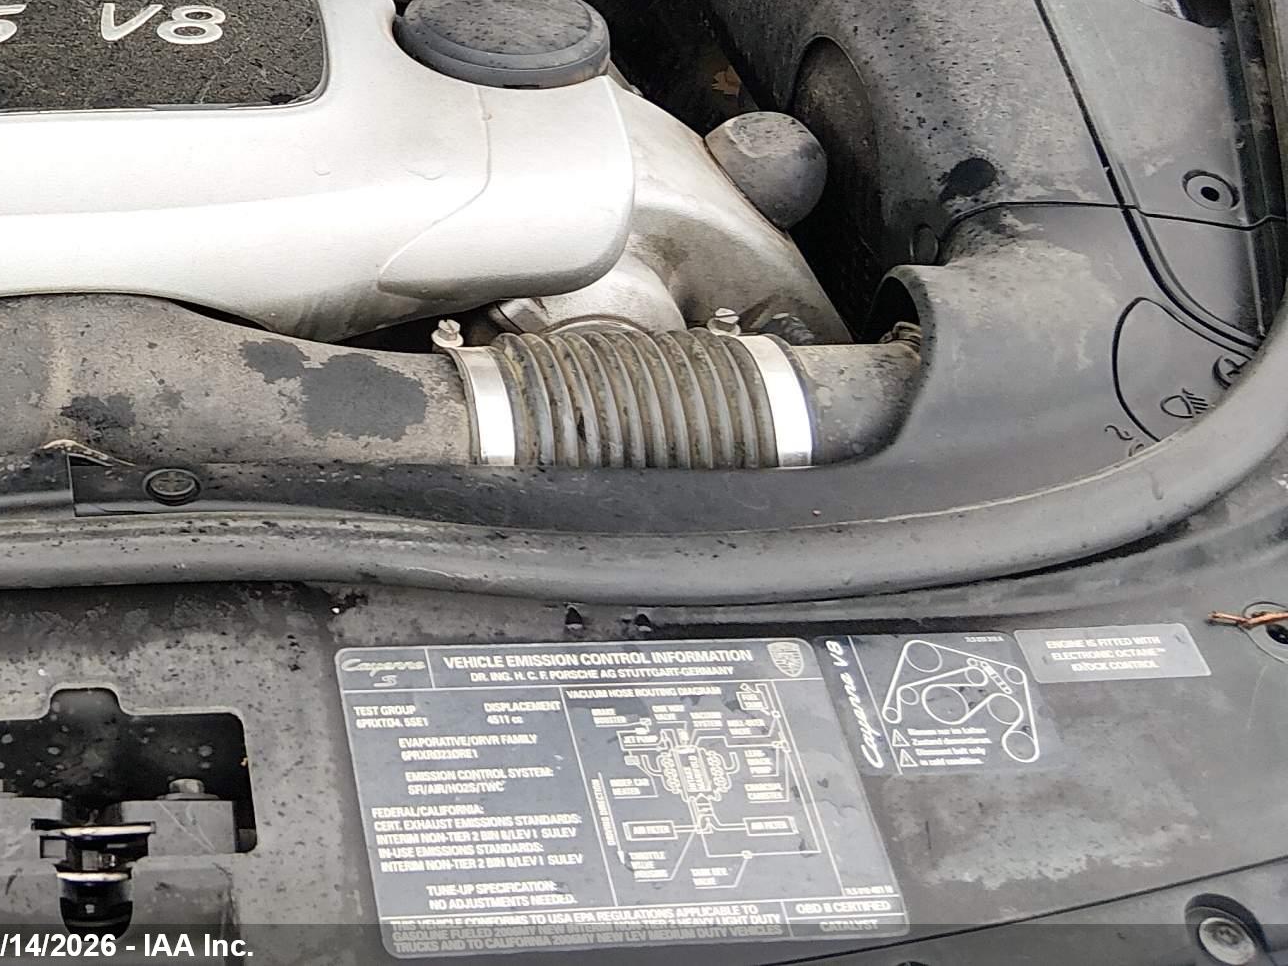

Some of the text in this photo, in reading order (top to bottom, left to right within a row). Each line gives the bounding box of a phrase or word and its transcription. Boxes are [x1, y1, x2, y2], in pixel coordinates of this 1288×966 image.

[100, 2, 226, 44] V8
[1045, 636, 1161, 649] ENGINE IS FITTED WITH
[443, 650, 753, 669] VEHICLE EMISSION CONTROL INFORMATION
[1051, 650, 1114, 661] ELECTRONIC
[471, 671, 489, 682] DR.
[491, 671, 513, 681] ING.
[514, 670, 526, 680] H.
[549, 668, 599, 680] PORSCHE
[601, 668, 617, 679] AG
[618, 666, 735, 678] STUTTGART-GERMANY
[566, 686, 722, 699] VACUUM HOSE ROUTING DIAGRAM
[353, 705, 416, 716] TEST GROUP
[484, 701, 562, 712] DISPLACEMENT
[825, 640, 884, 769] Cayenne V8
[501, 734, 538, 744] FAMILY
[405, 767, 554, 782] EMISSION CONTROL SYSTEM:
[371, 804, 485, 819] FEDERAL/CALIFORNIA:
[374, 813, 582, 832] CERT. EXHAUST EMISSIONS STANDARDS:
[376, 834, 420, 845] INTERIM
[421, 832, 470, 843] NON-TIER
[471, 832, 479, 841] 2
[542, 827, 577, 838] SULEV
[378, 842, 544, 859] IN-USE EMISSIONS STANDARDS:
[380, 861, 424, 872] INTERIM
[426, 858, 475, 871] NON-TIER
[476, 858, 485, 868] 2
[547, 854, 584, 866] SULEV
[426, 881, 558, 897] TUNE-UP SPECIFICATION:
[429, 895, 578, 910] NO ADJUSTMENTS NEEDED.
[833, 900, 891, 912] CERTIFIED
[390, 905, 758, 931] THIS VEHICLE CONFORMS TO USA EPA REGULATIONS APPLICABLE TO
[819, 919, 879, 932] CATALYST
[392, 931, 449, 942] GASOLINE
[451, 928, 492, 940] FUELED
[538, 925, 565, 936] NEW
[718, 915, 749, 926] LIGHT
[751, 913, 781, 924] DUTY
[393, 941, 439, 953] TRUCKS
[441, 940, 463, 951] AND
[468, 939, 484, 950] TO
[485, 935, 552, 948] CALIFORNIA
[597, 931, 624, 943] NEW
[699, 927, 728, 938] DUTY
[731, 925, 783, 936] VEHICLES
